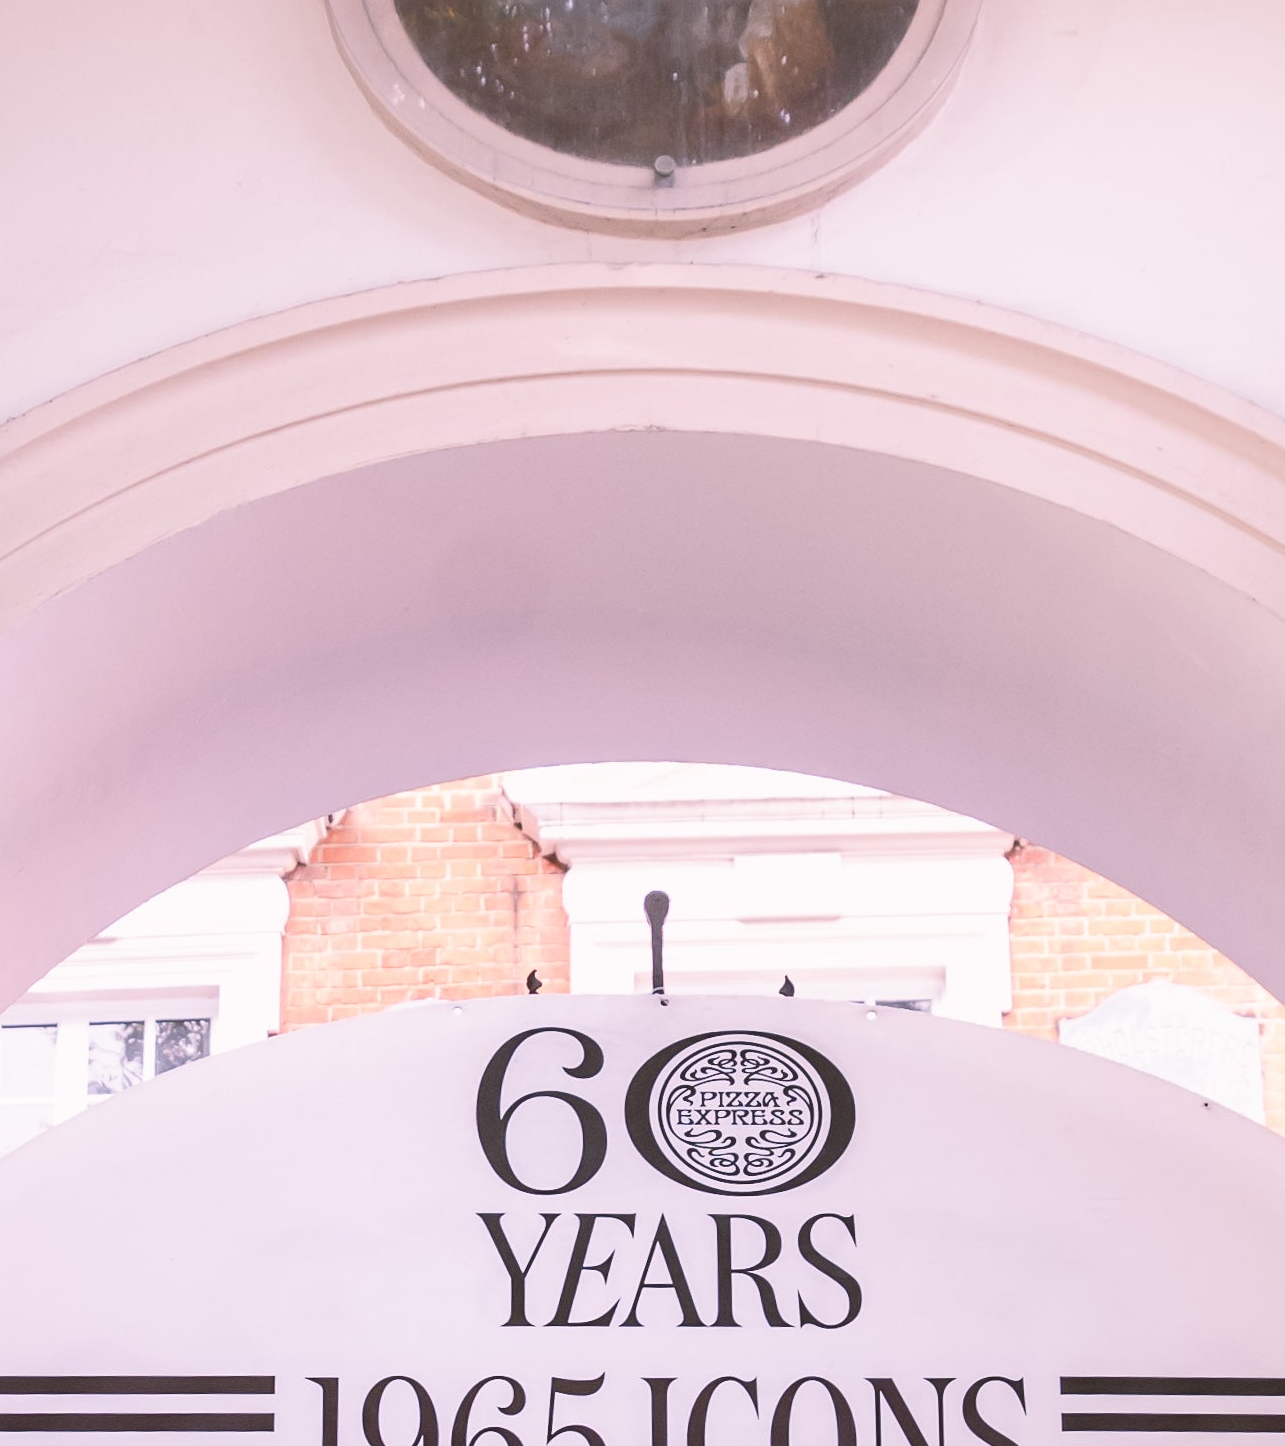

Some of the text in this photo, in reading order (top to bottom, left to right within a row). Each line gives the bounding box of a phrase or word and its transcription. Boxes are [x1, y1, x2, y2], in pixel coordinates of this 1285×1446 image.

[700, 1092, 781, 1107] PIZZA
[677, 1109, 804, 1125] EXPRESS
[476, 1212, 862, 1329] YEARS
